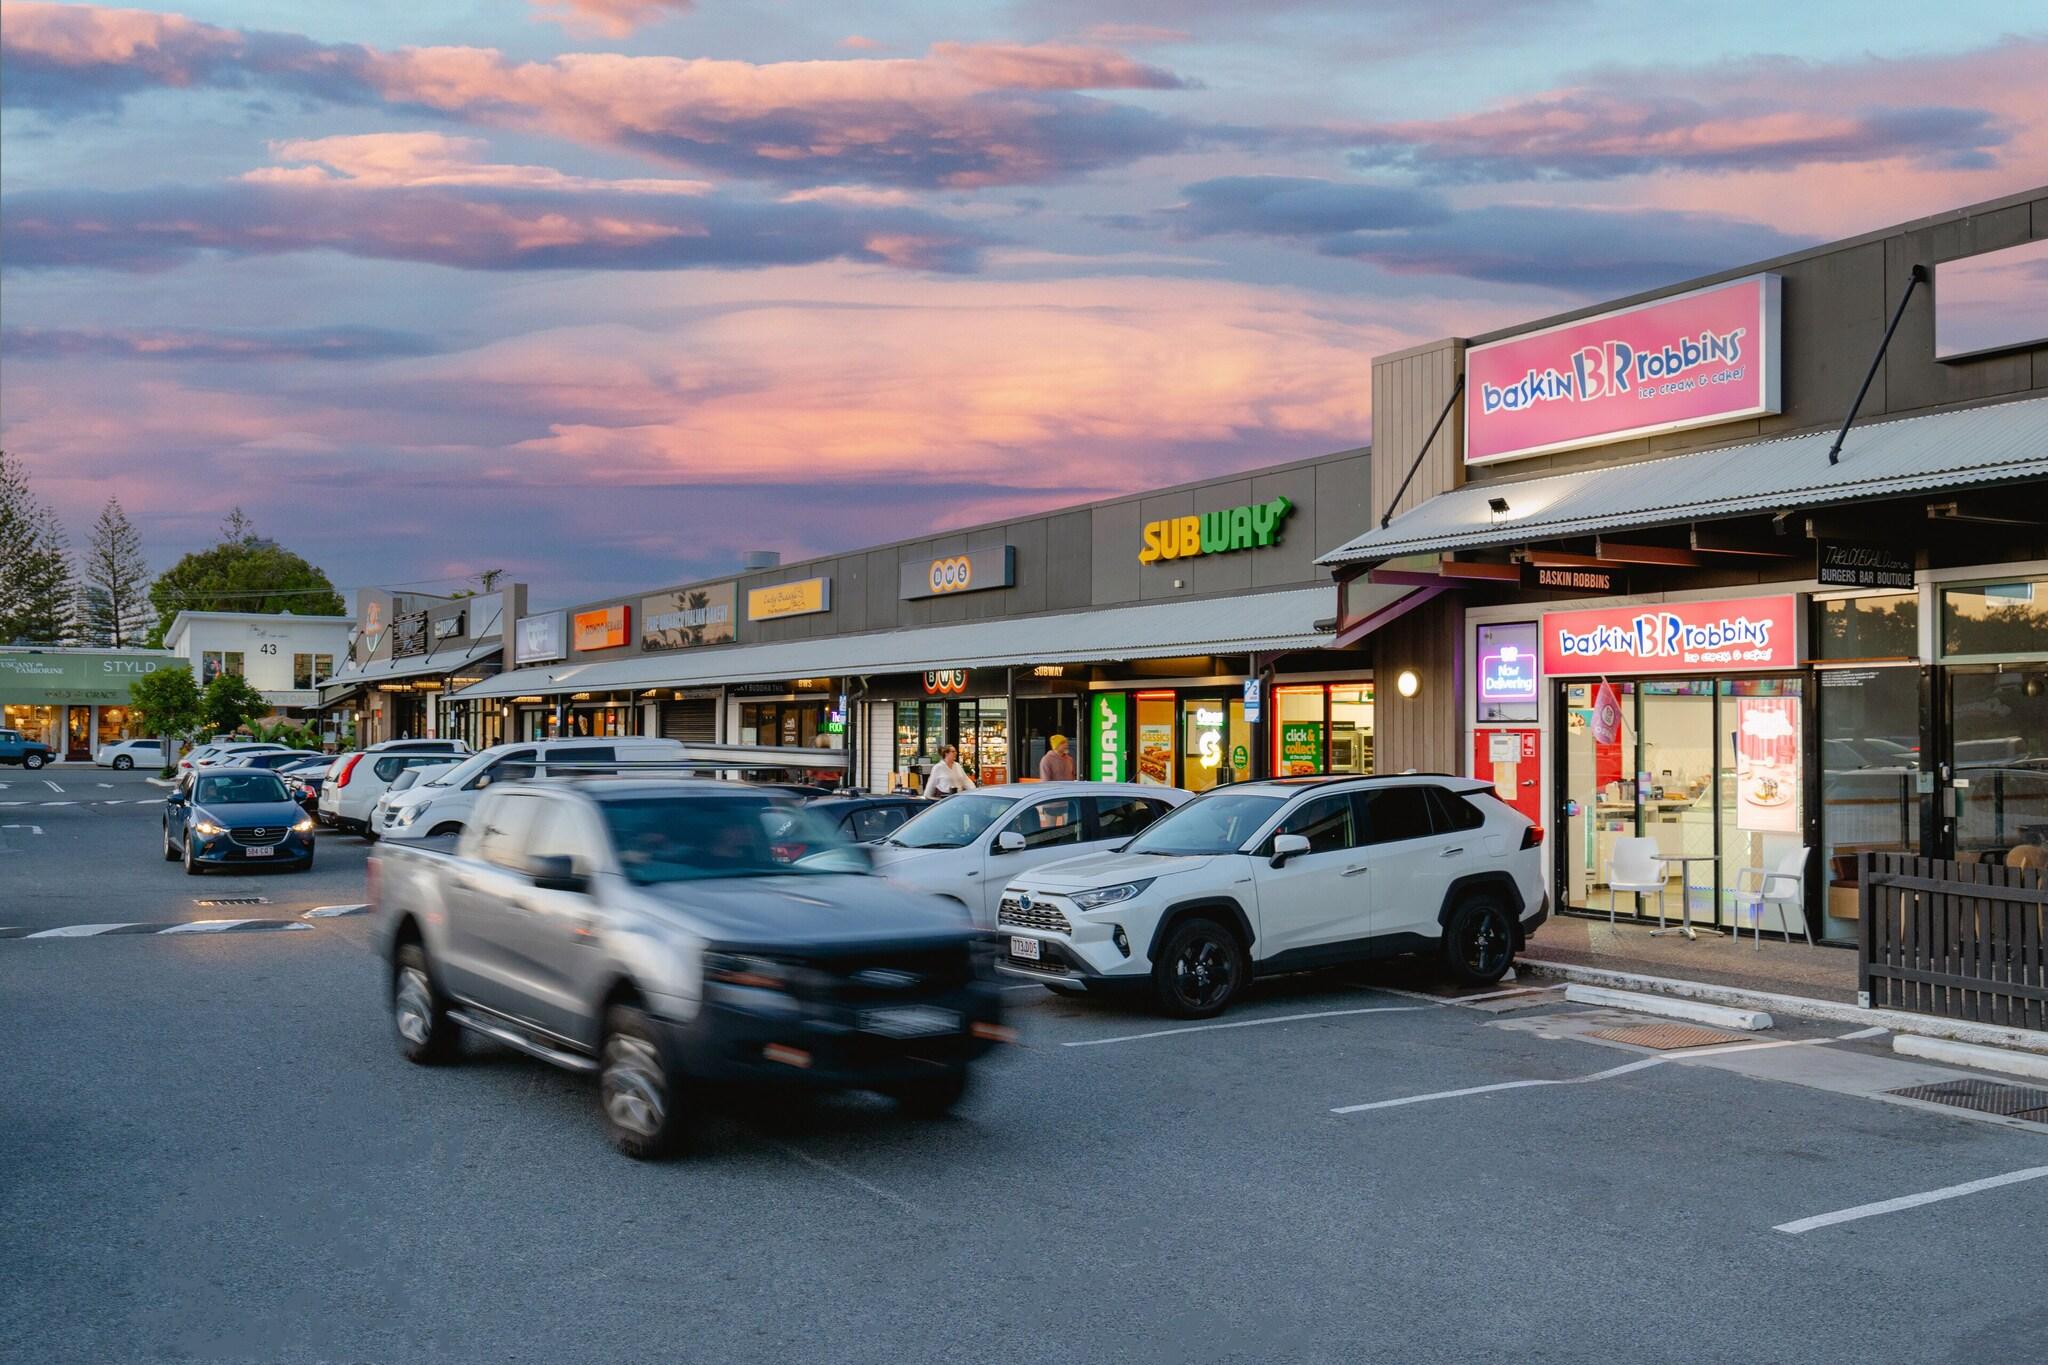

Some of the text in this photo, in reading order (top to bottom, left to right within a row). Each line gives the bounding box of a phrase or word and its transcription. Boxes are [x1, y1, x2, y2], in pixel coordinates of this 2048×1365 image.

[1482, 328, 1746, 415] baskin BR robbins
[1639, 365, 1746, 400] ice cream & cakes
[1138, 496, 1293, 566] SUBWAY
[931, 560, 969, 588] BWS
[1539, 569, 1610, 589] BASKIN ROBBINS
[1821, 568, 1912, 587] BURGERS BAR BOUTIQUE
[1559, 624, 1634, 657] baskin
[1632, 613, 1682, 657] BR
[1683, 617, 1773, 651] robbins
[260, 643, 277, 655] 43
[103, 661, 156, 673] STYLD
[1034, 665, 1064, 677] SUBWAY
[1498, 664, 1519, 677] Now
[926, 670, 965, 689] BWS
[1486, 677, 1533, 692] Delivering
[1286, 728, 1316, 742] click &
[1285, 741, 1317, 755] collect
